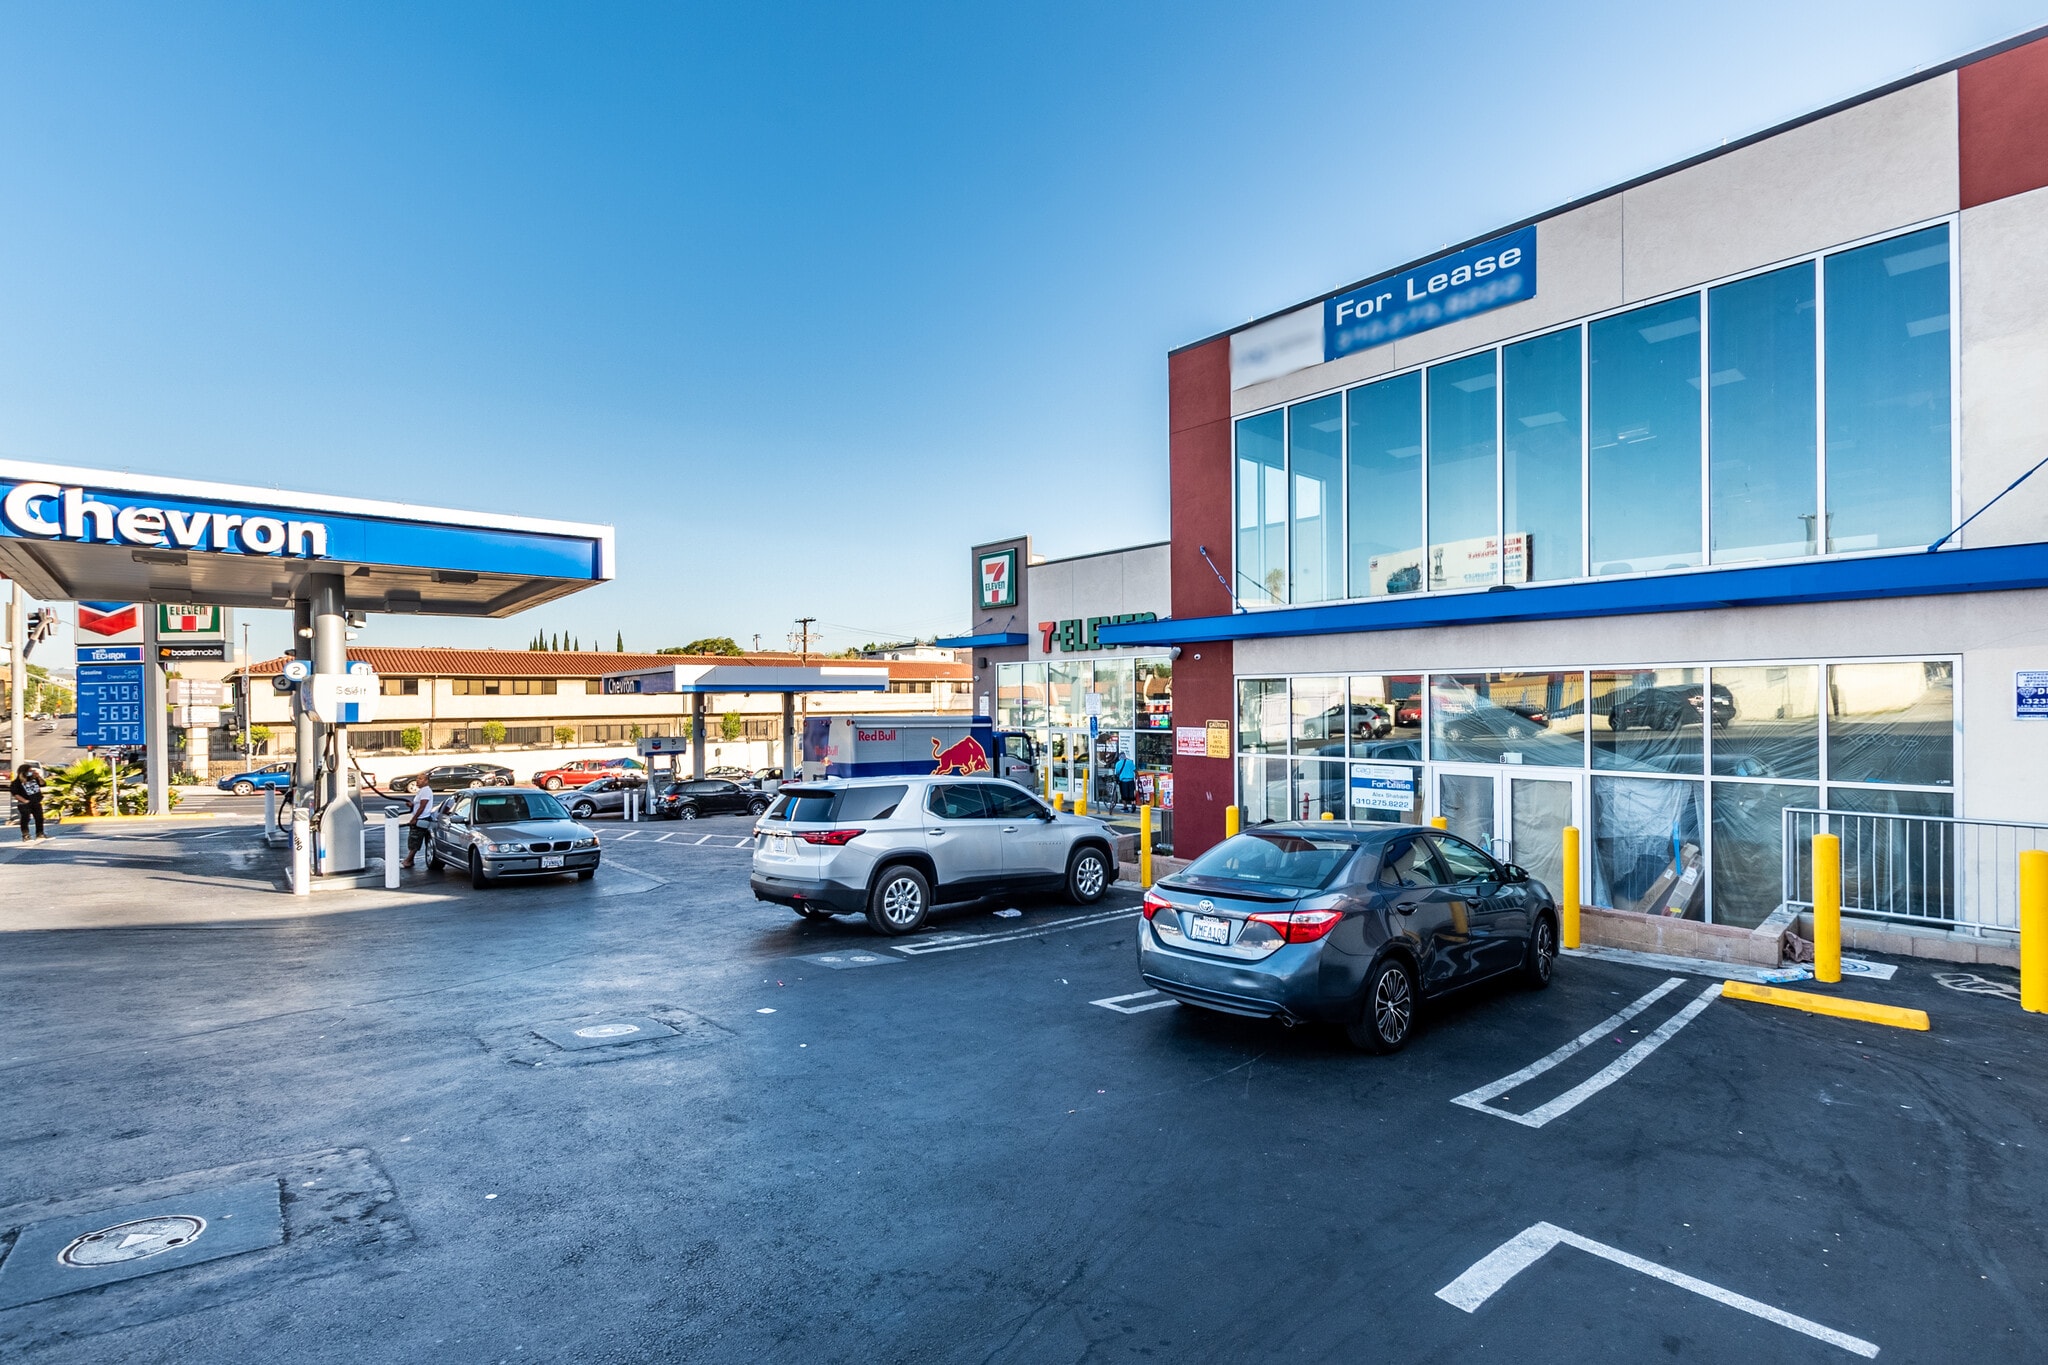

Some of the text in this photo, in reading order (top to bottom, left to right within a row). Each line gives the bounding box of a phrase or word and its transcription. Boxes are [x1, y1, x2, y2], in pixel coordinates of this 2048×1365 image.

[1336, 292, 1392, 327] For
[1406, 247, 1522, 302] Lease
[5, 481, 328, 556] Chevron
[1038, 611, 1157, 654] 7-ELE
[91, 652, 127, 661] TECHRON
[292, 666, 301, 676] 2
[278, 678, 287, 687] 4
[608, 678, 635, 694] Chevron
[858, 729, 897, 742] Red Bull
[1371, 779, 1387, 788] For
